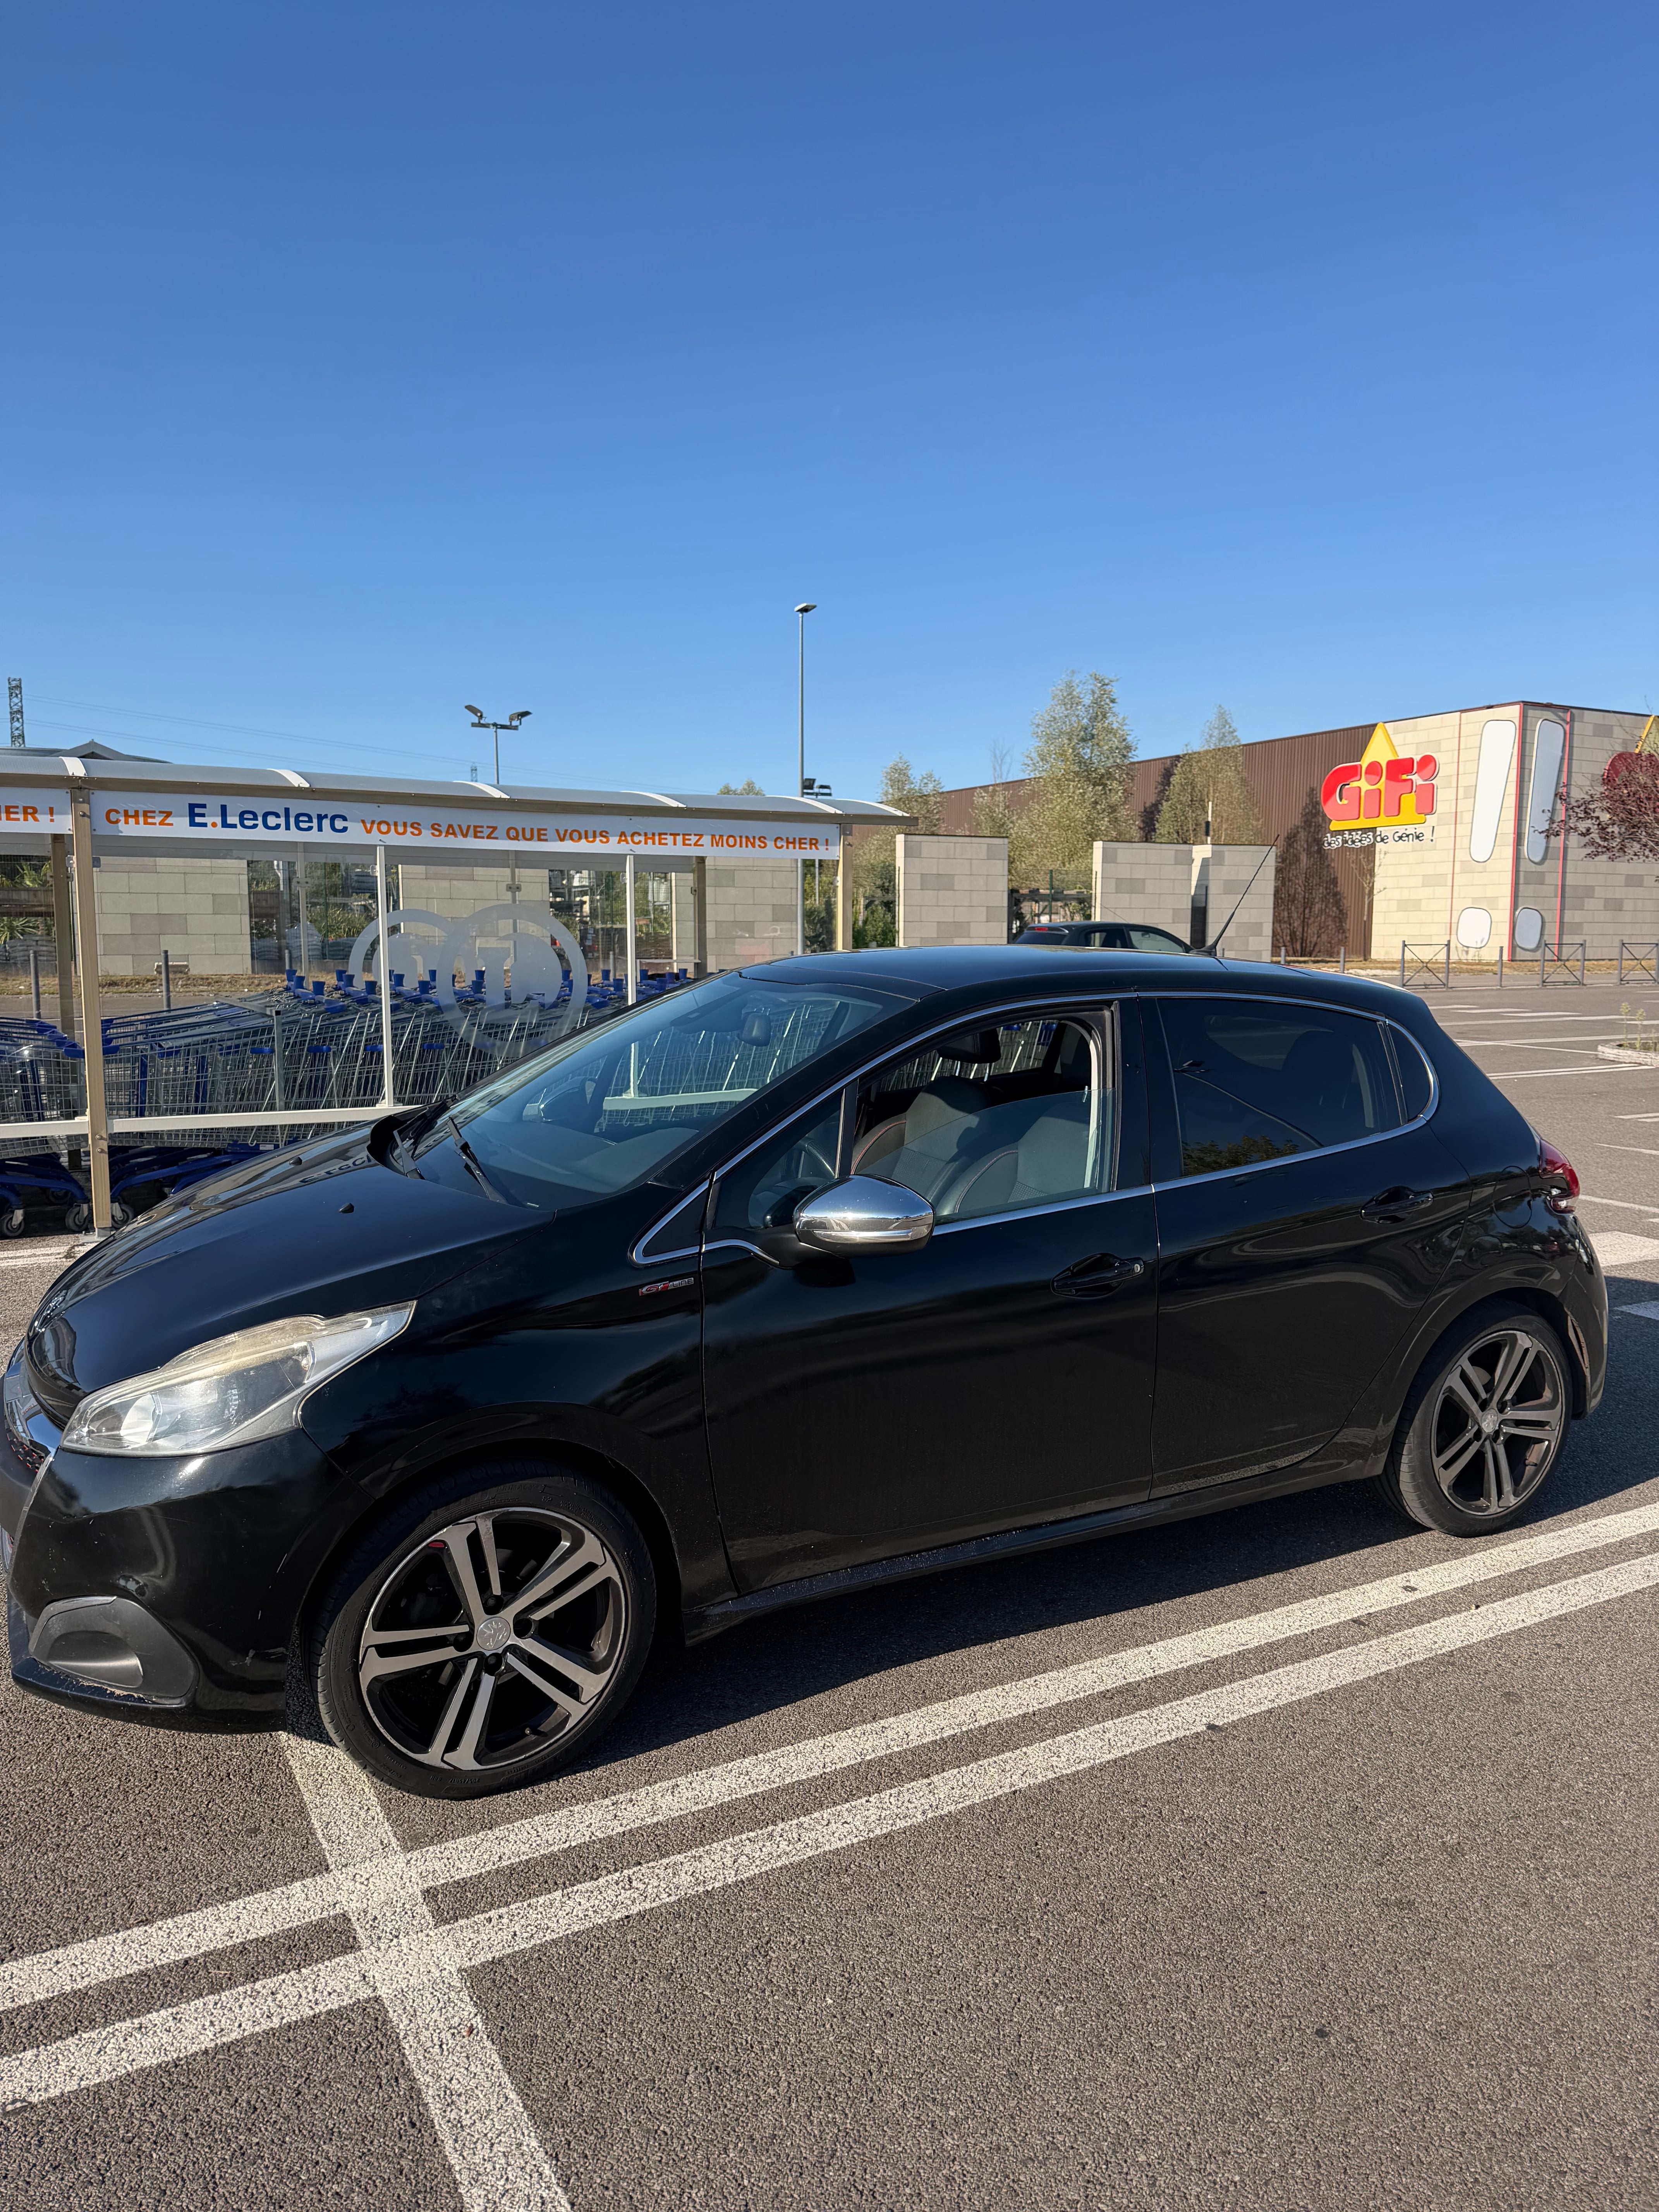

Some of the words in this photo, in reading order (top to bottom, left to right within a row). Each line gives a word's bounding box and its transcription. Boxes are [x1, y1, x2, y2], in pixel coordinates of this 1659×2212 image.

[0, 805, 40, 822] ER
[48, 807, 54, 822] !
[105, 809, 173, 827] CHEZ
[189, 803, 348, 833] E.Leclerc
[361, 819, 422, 837] VOUS
[430, 823, 498, 840] SAVEZ
[506, 826, 548, 842] QUE
[555, 829, 610, 845] VOUS
[617, 831, 704, 848] ACHETEZ
[710, 834, 768, 849] MOINS
[773, 836, 819, 851] CHER
[825, 838, 829, 851] !
[1375, 831, 1389, 844] de
[1393, 828, 1424, 842] Génie
[1431, 826, 1434, 842] !
[642, 1281, 669, 1294] GT
